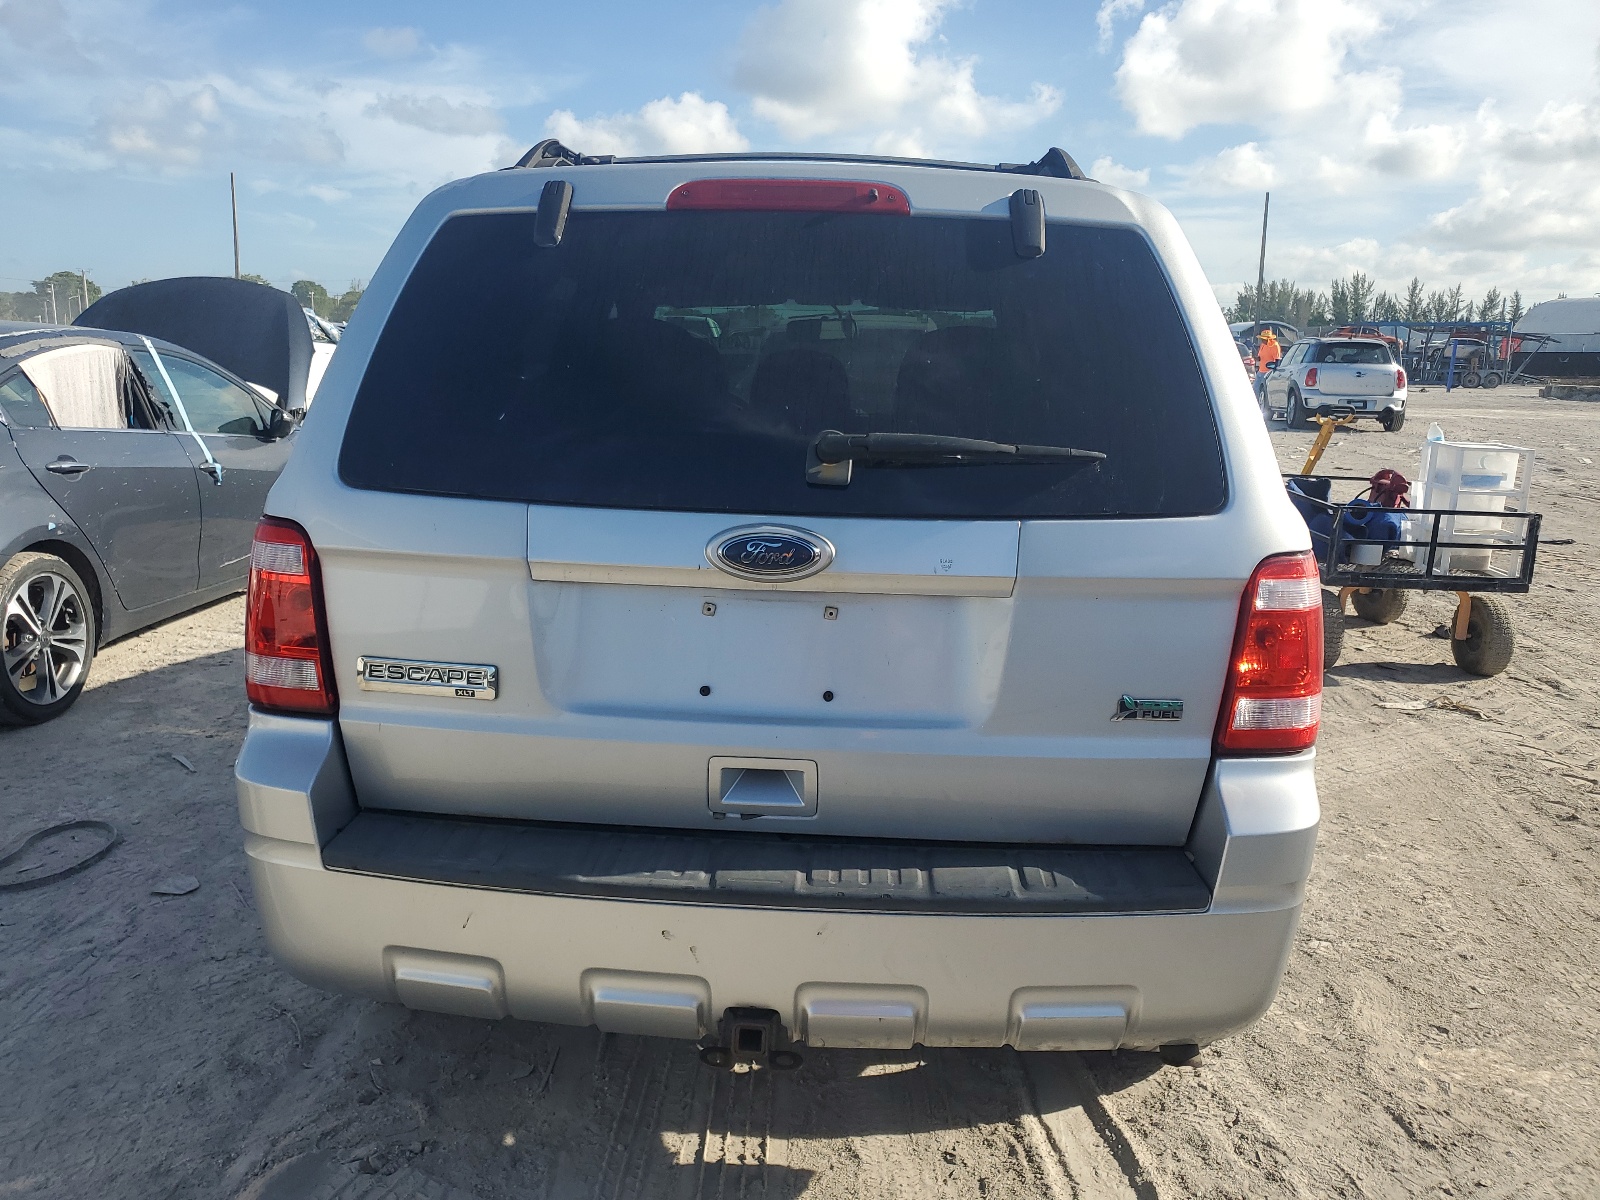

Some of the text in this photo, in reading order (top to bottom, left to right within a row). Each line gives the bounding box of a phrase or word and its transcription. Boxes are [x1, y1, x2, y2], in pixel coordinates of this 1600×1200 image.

[740, 540, 796, 565] Ford
[368, 663, 485, 687] ESCAPE
[456, 689, 474, 697] XLT
[1142, 710, 1180, 718] FUEL
